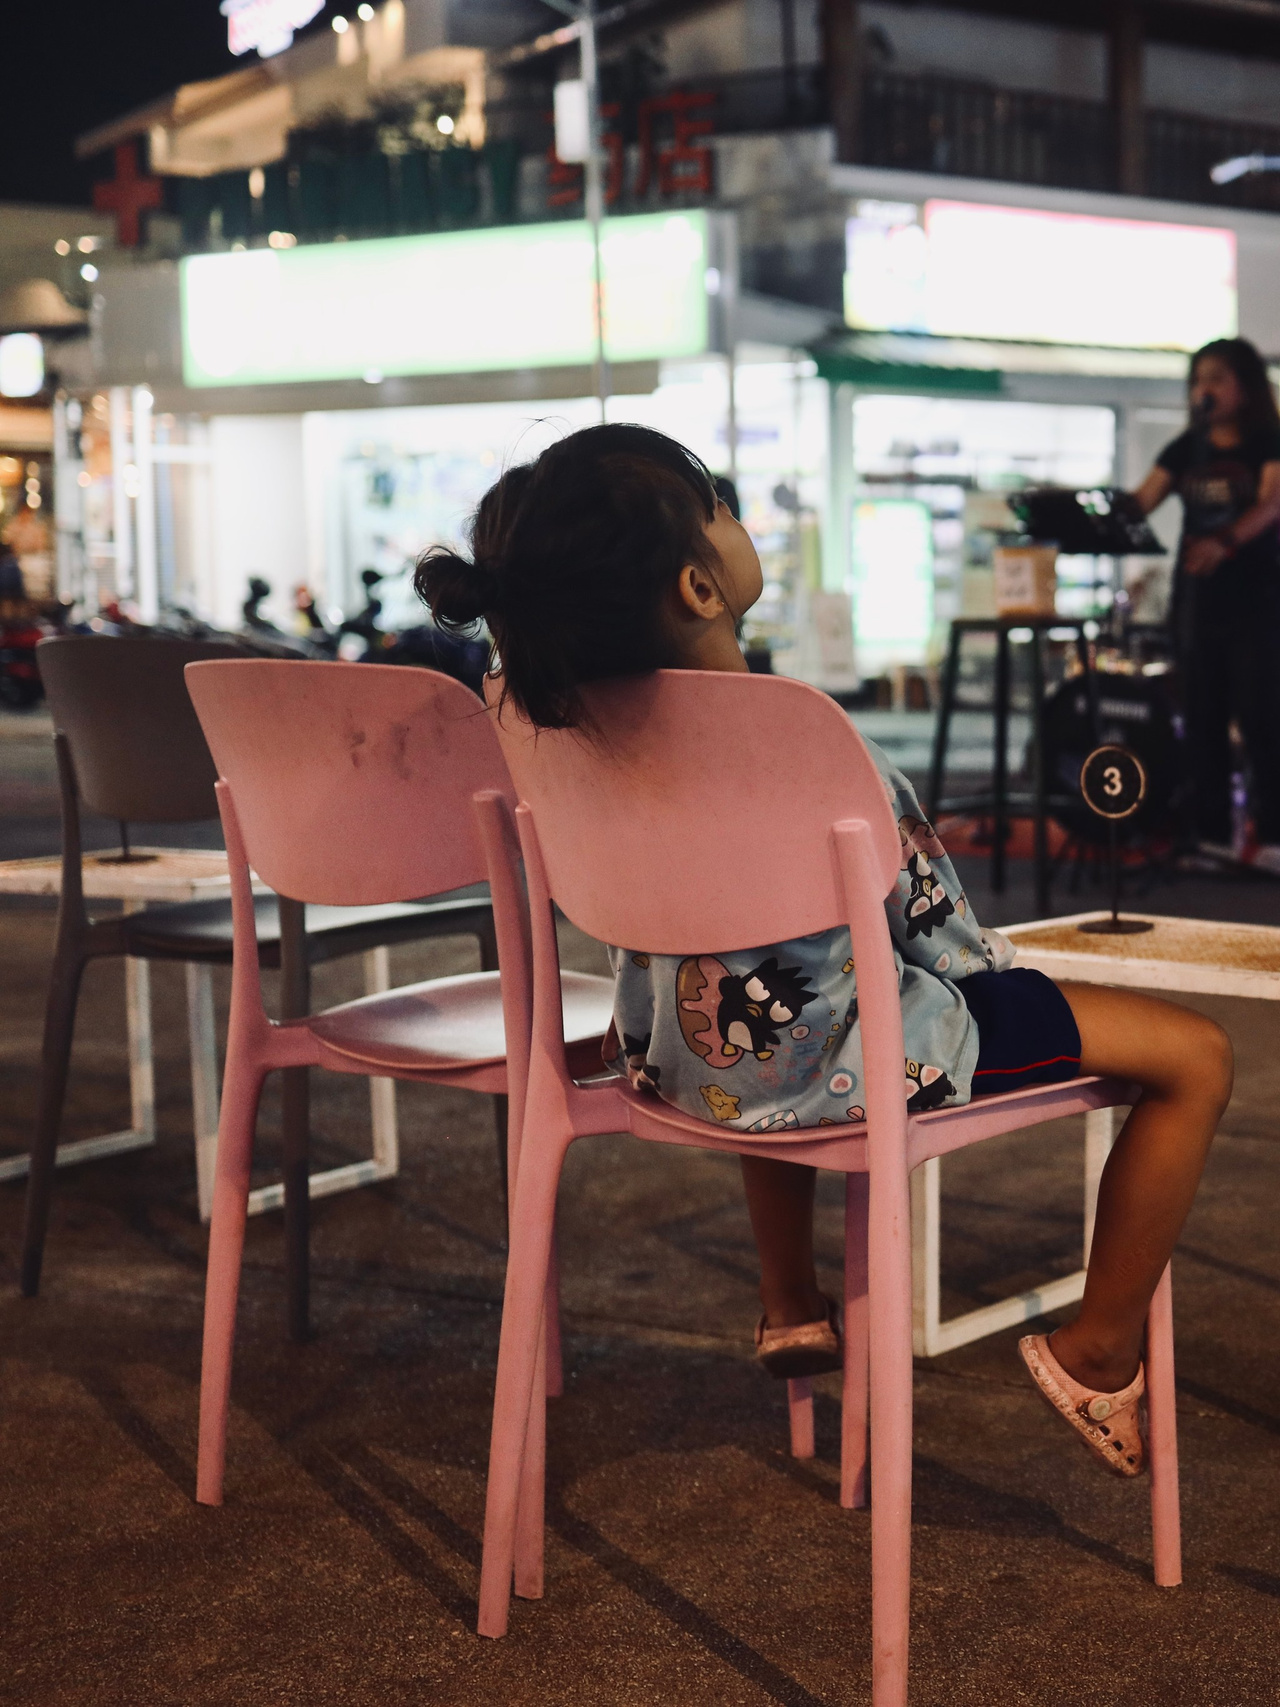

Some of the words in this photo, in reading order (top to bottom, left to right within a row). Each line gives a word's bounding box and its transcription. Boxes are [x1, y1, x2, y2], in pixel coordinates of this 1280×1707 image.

[1103, 766, 1123, 796] 3
[1067, 1409, 1098, 1438] comes
[1097, 1437, 1119, 1463] from
